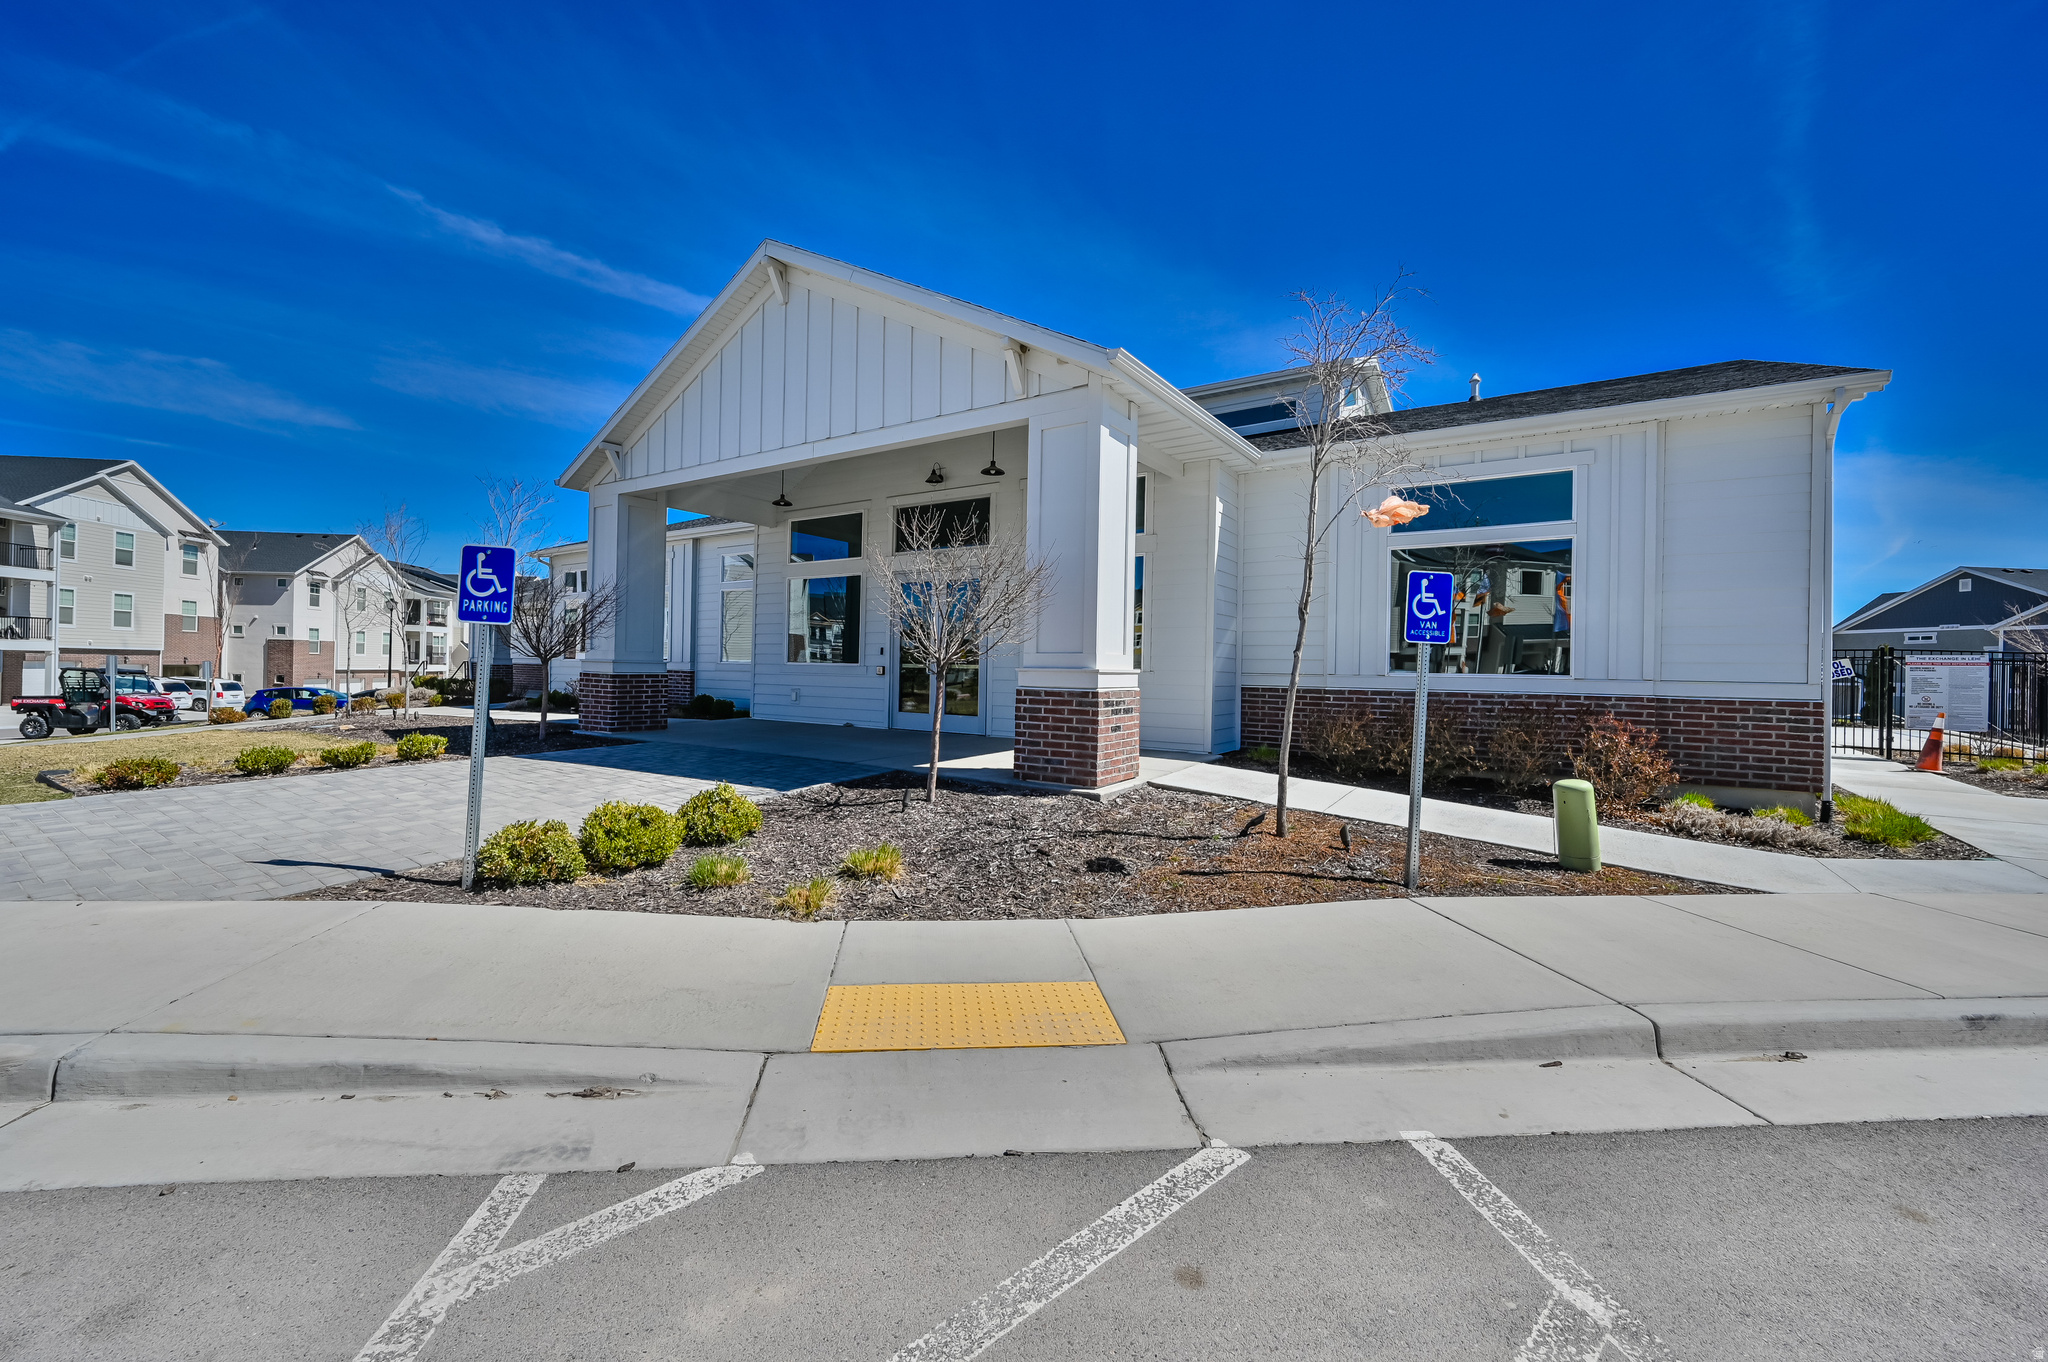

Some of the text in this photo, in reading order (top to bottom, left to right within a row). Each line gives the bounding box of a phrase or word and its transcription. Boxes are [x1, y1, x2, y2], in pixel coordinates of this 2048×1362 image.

[462, 598, 508, 614] PARKING
[1420, 620, 1438, 629] VAN
[1410, 629, 1446, 637] ACCESSIBLE
[1832, 660, 1846, 670] OL
[1832, 667, 1853, 679] SED
